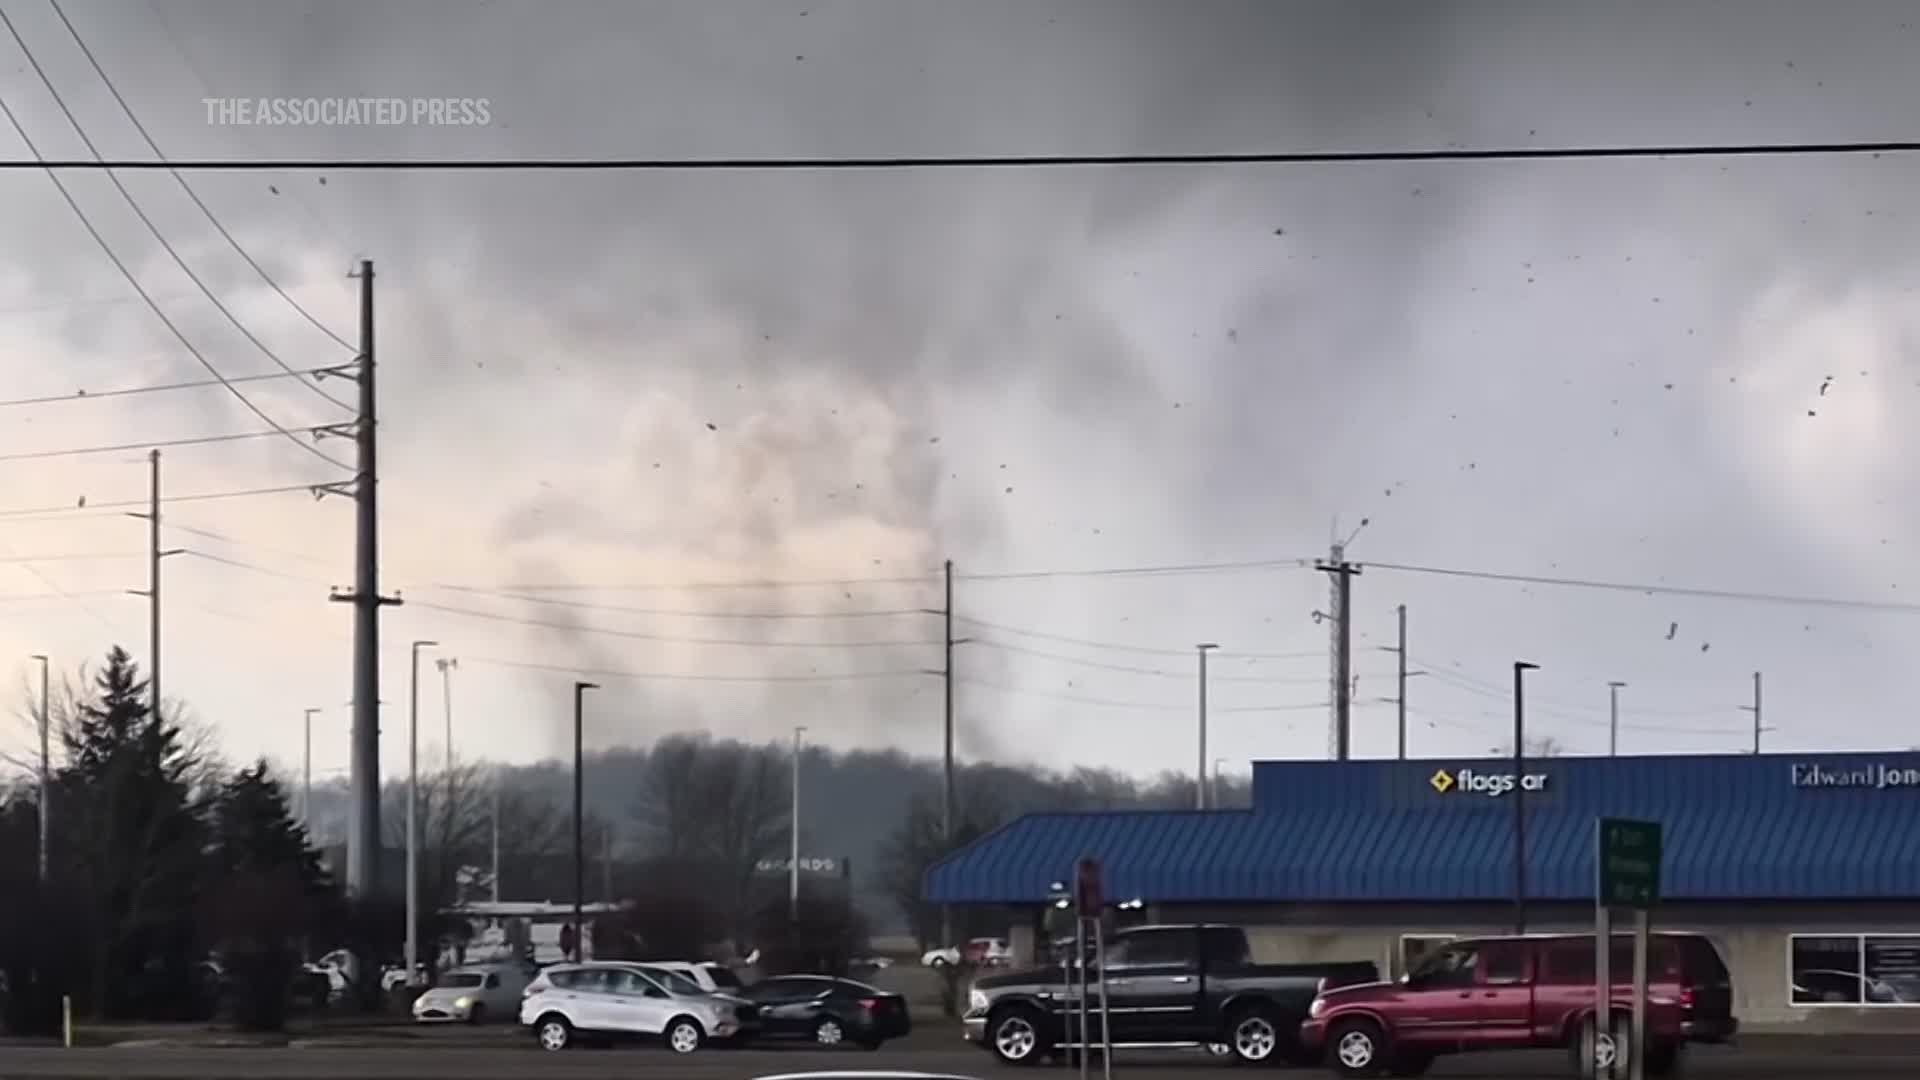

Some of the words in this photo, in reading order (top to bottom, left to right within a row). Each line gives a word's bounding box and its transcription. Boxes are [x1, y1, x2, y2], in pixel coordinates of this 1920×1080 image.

[1458, 769, 1547, 796] flagsar
[1791, 763, 1874, 785] Edward
[1876, 763, 1920, 789] Jon
